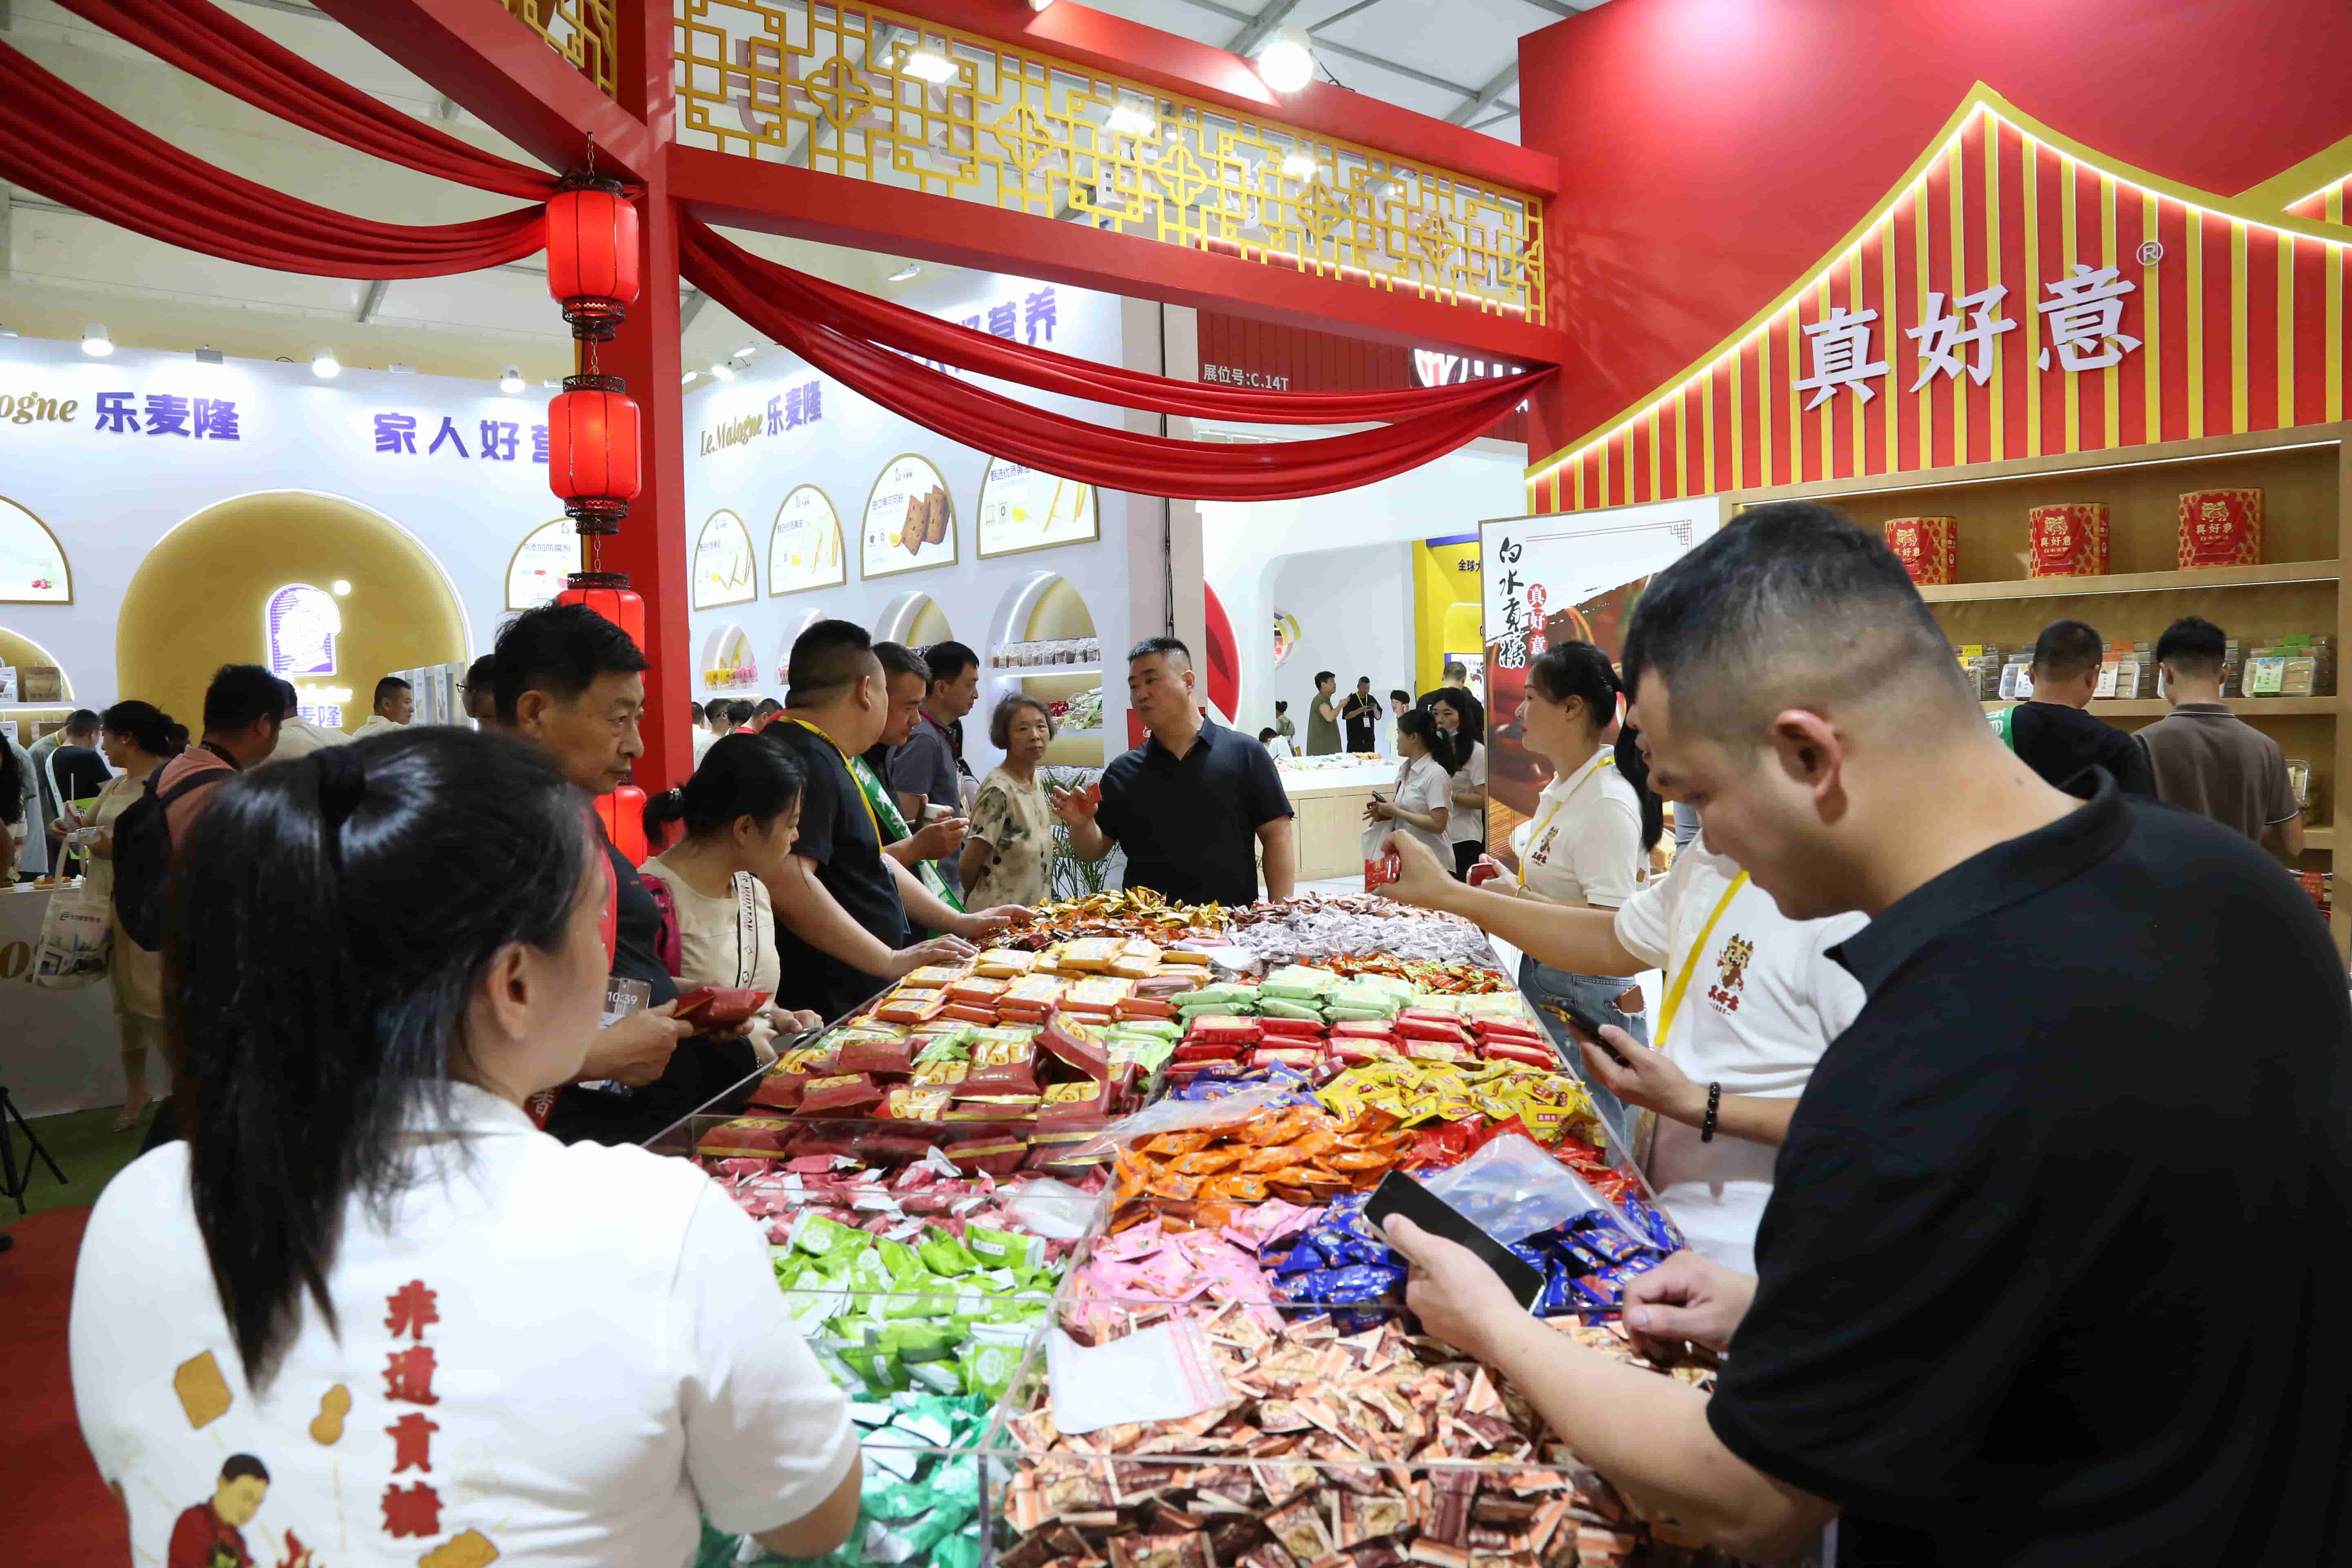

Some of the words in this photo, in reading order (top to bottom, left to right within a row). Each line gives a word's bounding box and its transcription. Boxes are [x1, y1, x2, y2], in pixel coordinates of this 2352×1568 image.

[1792, 264, 2143, 412] 真好意
[1203, 363, 1289, 392] 展位号:C.14T
[94, 392, 240, 441] 乐麦隆
[767, 380, 822, 437] 乐麦隆
[2040, 535, 2072, 547] 真好意
[2195, 522, 2234, 535] 真好意
[1529, 586, 1546, 655] 真好意
[607, 991, 638, 1004] 10:39
